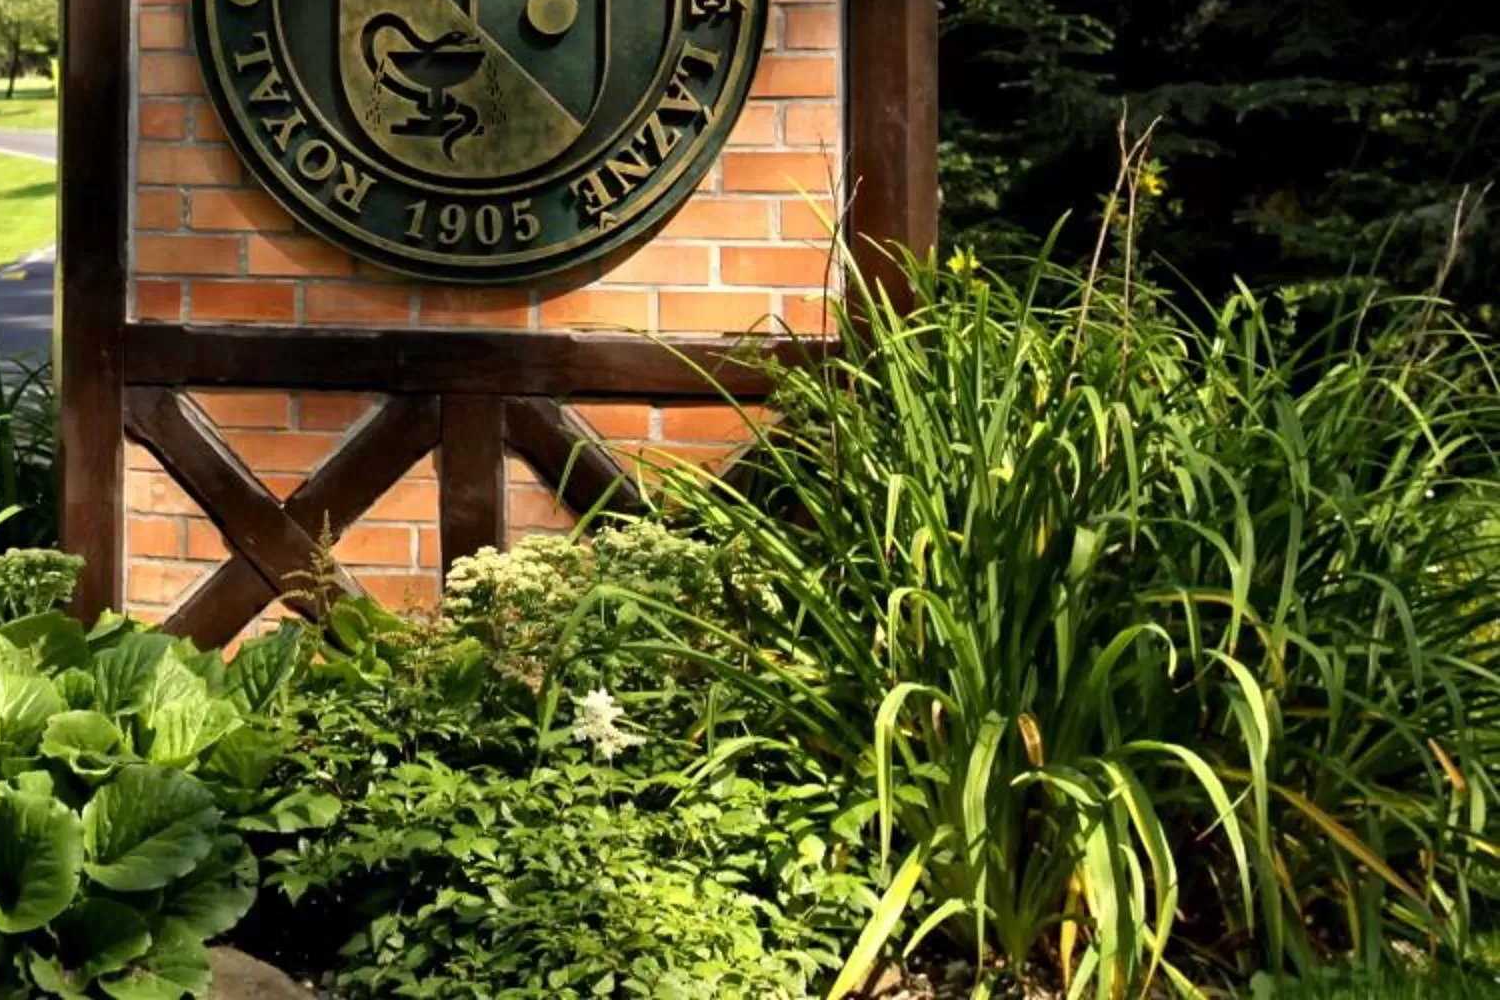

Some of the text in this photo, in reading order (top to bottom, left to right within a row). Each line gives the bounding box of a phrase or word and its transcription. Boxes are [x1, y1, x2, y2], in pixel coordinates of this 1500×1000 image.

[234, 31, 377, 216] ROYAL
[569, 40, 720, 231] LÁZNĚ
[405, 200, 541, 246] 1905
